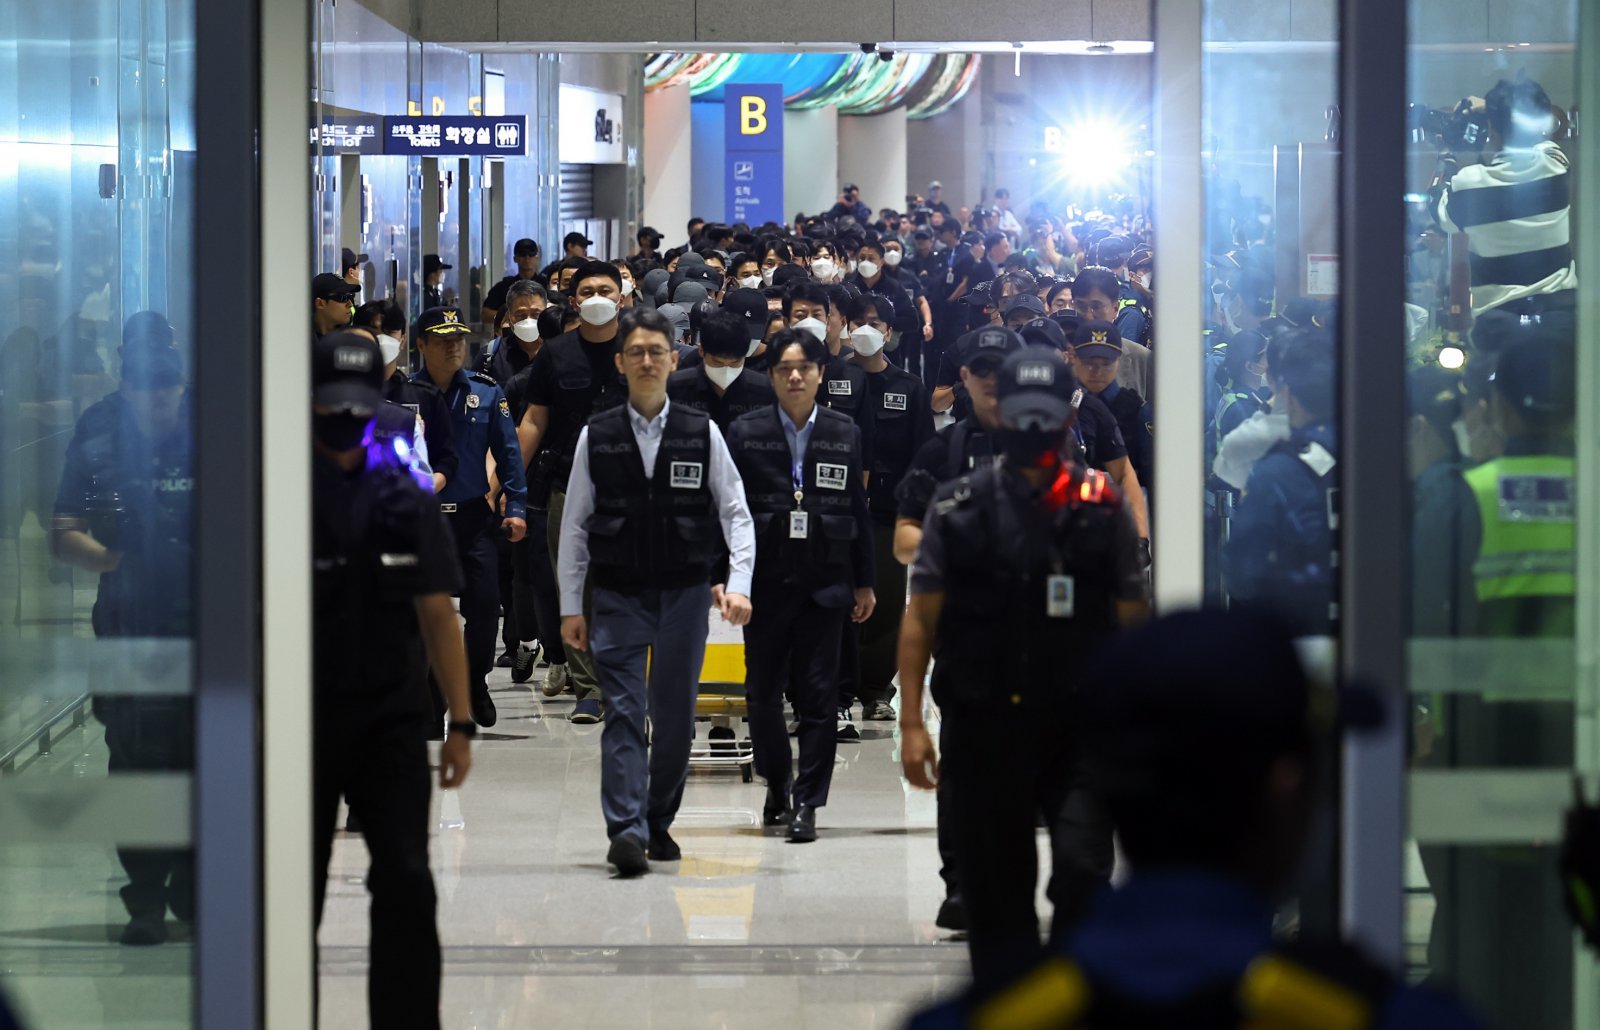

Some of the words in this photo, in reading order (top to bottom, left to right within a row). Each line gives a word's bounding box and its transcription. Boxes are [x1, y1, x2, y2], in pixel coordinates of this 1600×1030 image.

[741, 96, 767, 135] B
[446, 127, 490, 145] 화장실
[1044, 126, 1061, 151] B
[593, 443, 632, 454] POLICE
[664, 438, 704, 448] POLICE
[744, 440, 784, 450] POLICE
[812, 441, 851, 452] POLICE
